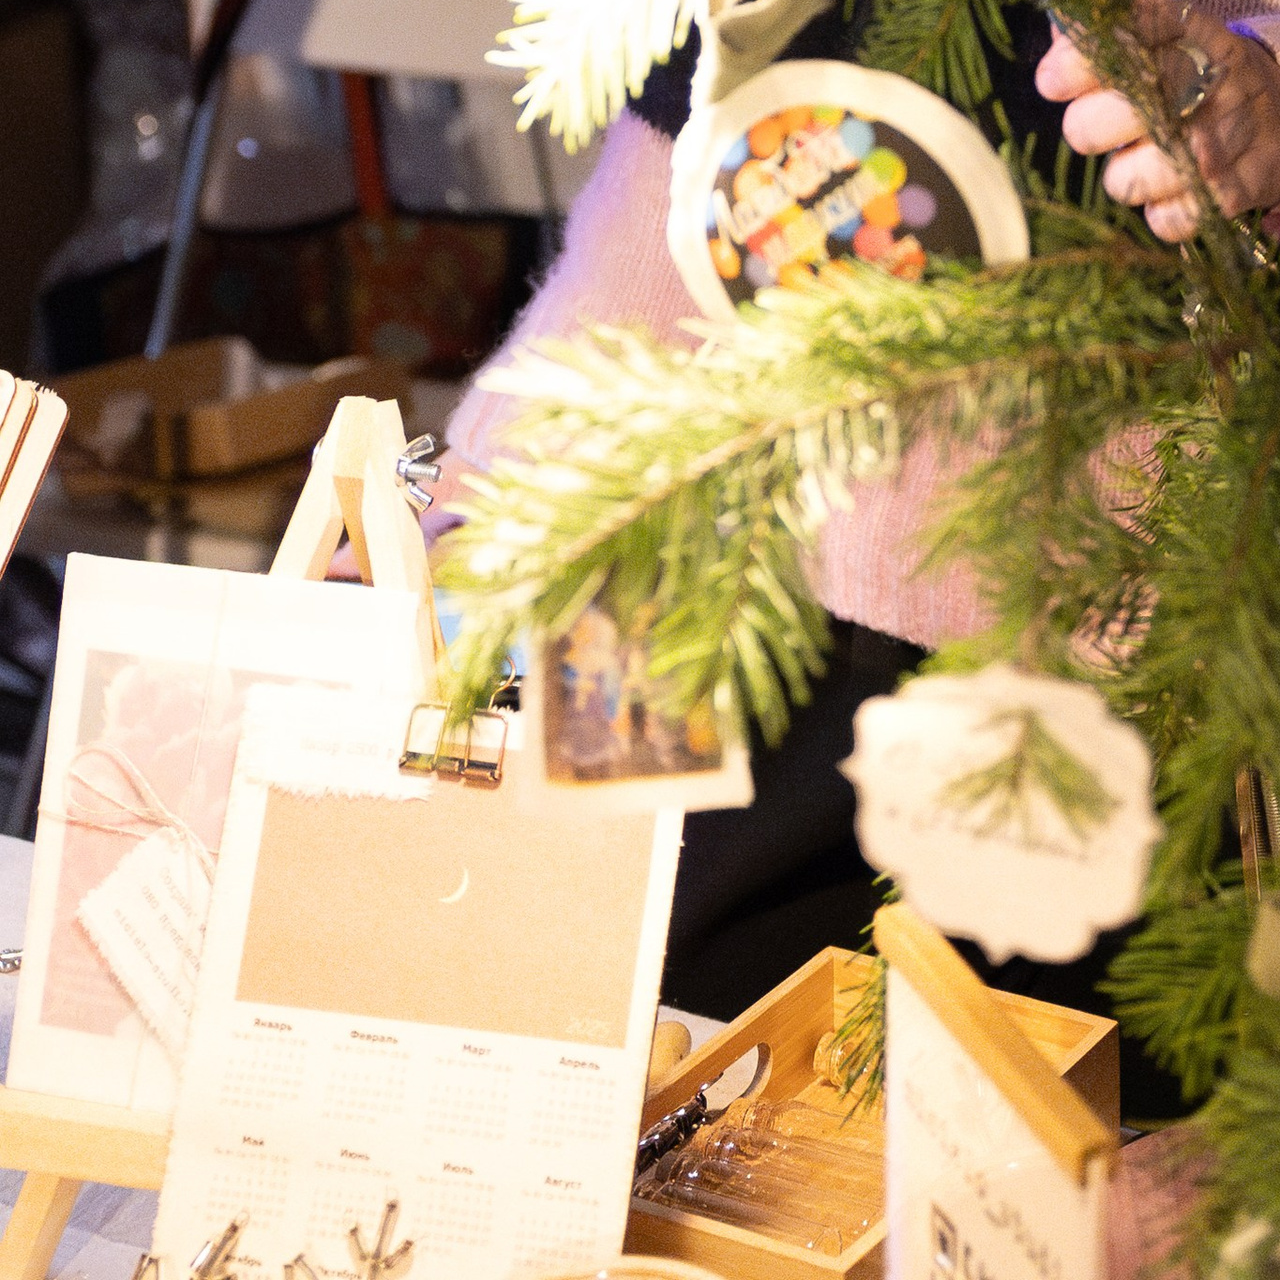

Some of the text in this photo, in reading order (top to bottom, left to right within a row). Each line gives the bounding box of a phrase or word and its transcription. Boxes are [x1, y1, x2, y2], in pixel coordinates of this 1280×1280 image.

[253, 1017, 293, 1032] Январь
[349, 1030, 399, 1044] Февраль
[462, 1043, 492, 1056] Март
[559, 1056, 601, 1071] Апрель
[242, 1135, 265, 1147] Май
[340, 1148, 370, 1161] Июнь
[443, 1162, 474, 1175] Июль
[544, 1176, 582, 1190] Август
